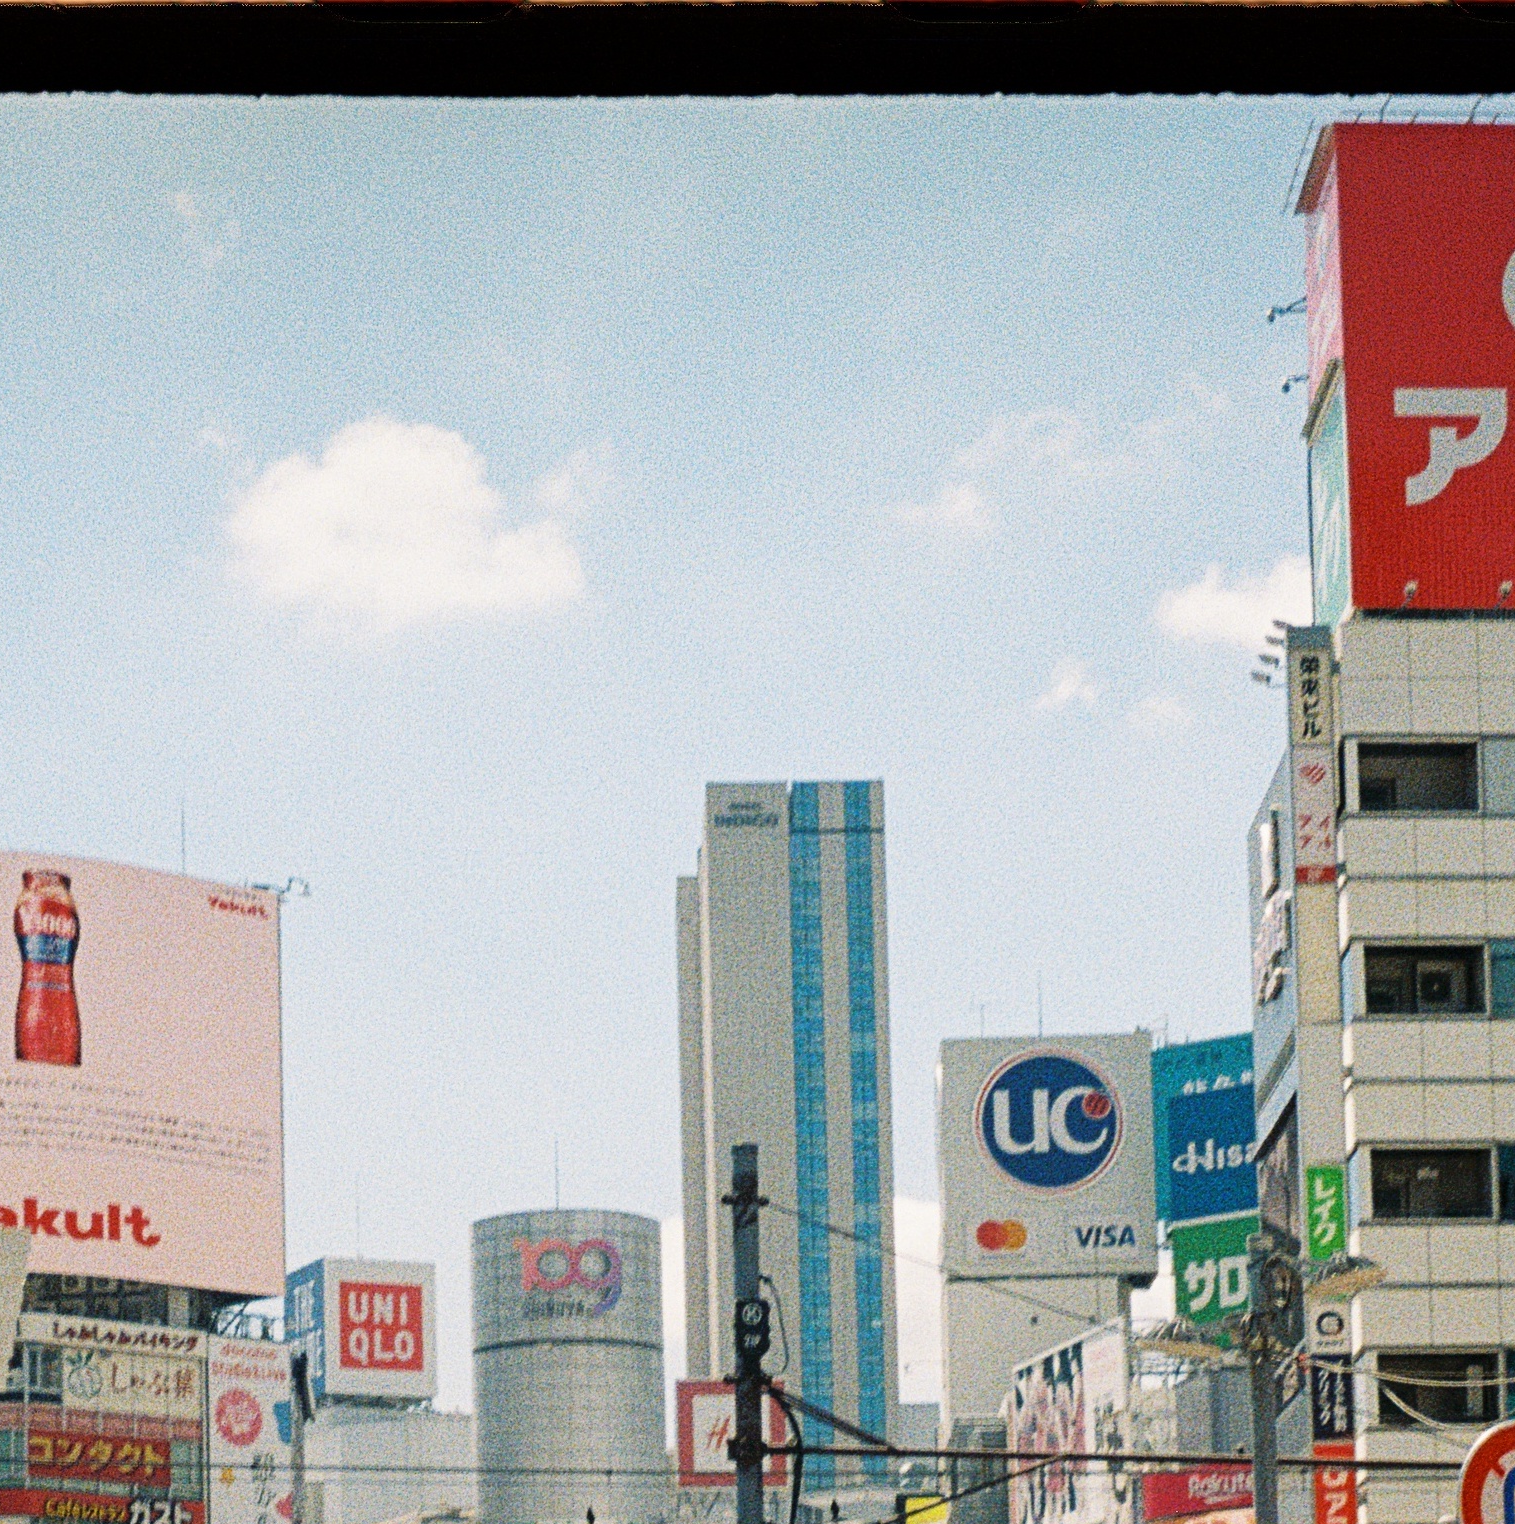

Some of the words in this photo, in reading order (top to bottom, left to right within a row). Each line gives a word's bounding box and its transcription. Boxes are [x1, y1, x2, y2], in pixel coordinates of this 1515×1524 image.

[209, 896, 269, 920] Yakult
[1314, 1177, 1338, 1245] レイク
[1075, 1226, 1136, 1248] VISA
[512, 1238, 622, 1317] 109
[348, 1290, 408, 1326] UNI
[348, 1328, 415, 1366] QLO
[29, 1435, 165, 1478] コンタクト
